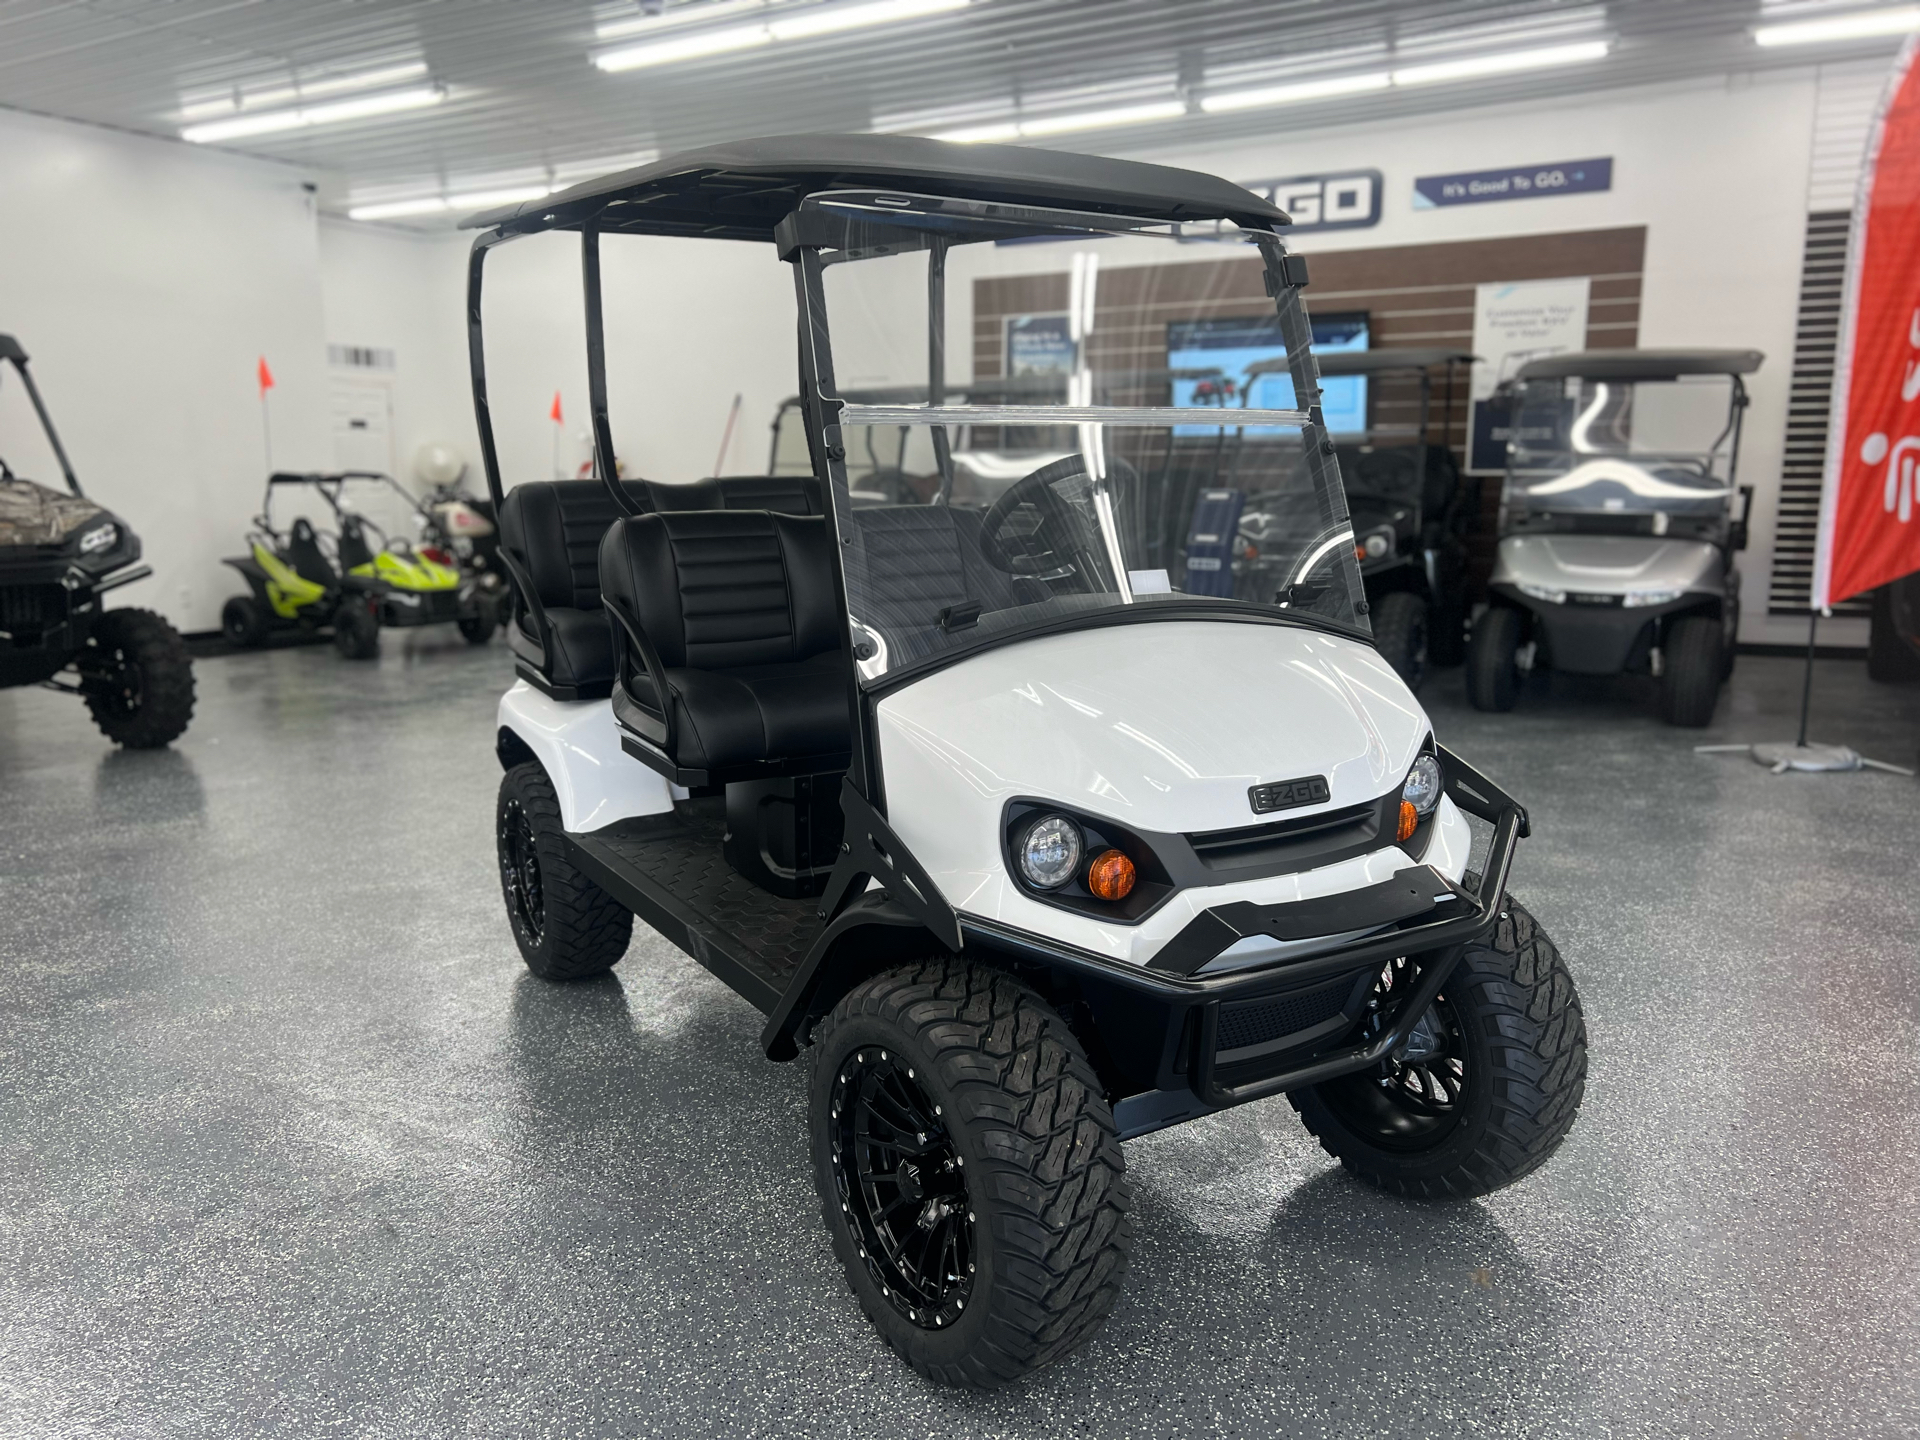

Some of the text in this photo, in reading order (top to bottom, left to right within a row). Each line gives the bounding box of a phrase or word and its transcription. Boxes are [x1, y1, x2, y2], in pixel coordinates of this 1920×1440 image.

[1442, 182, 1466, 198] It's
[1468, 177, 1510, 195] Good
[1512, 174, 1531, 190] To
[1253, 780, 1326, 811] EZGO
